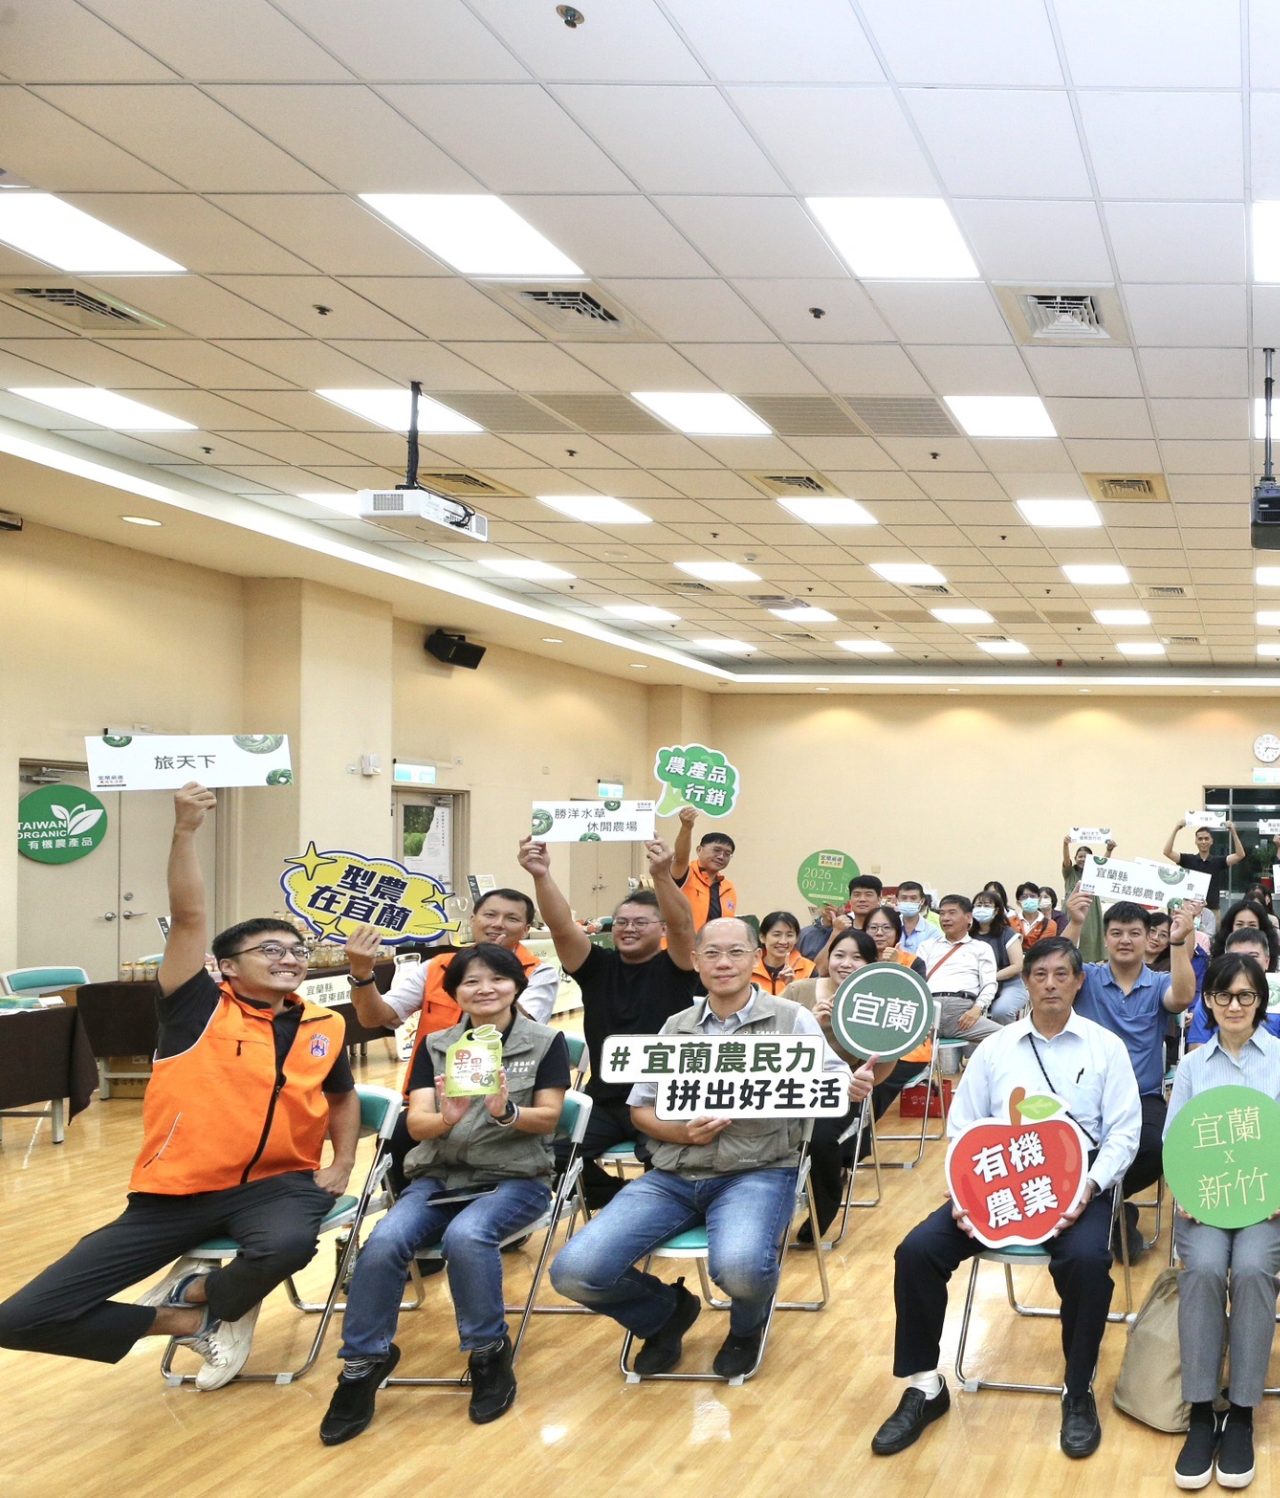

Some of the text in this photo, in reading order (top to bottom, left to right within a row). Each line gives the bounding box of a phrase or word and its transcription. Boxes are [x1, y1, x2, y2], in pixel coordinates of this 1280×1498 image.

[154, 755, 216, 769] 旅天下
[665, 756, 728, 784] 農產品
[684, 783, 727, 807] 行銷
[17, 820, 67, 831] TAIWAN
[554, 807, 606, 820] 勝洋水草
[16, 830, 67, 840] ORGANIC
[587, 821, 638, 833] 休閒農場
[28, 837, 93, 850] 有機農產品
[337, 864, 410, 905] 型農
[803, 867, 831, 880] 2026
[1096, 867, 1128, 881] 宜蘭縣
[1110, 882, 1165, 901] 五結鄉農會
[307, 885, 413, 932] 在宜蘭
[307, 983, 333, 995] 宜蘭縣
[846, 992, 920, 1033] 宜蘭
[609, 1042, 816, 1074] # 宜蘭農民力
[666, 1077, 842, 1111] 拼出好生活
[1190, 1106, 1262, 1150] 宜蘭
[972, 1131, 1047, 1184] 有機
[1198, 1166, 1270, 1210] 新竹
[986, 1175, 1059, 1229] 農業
